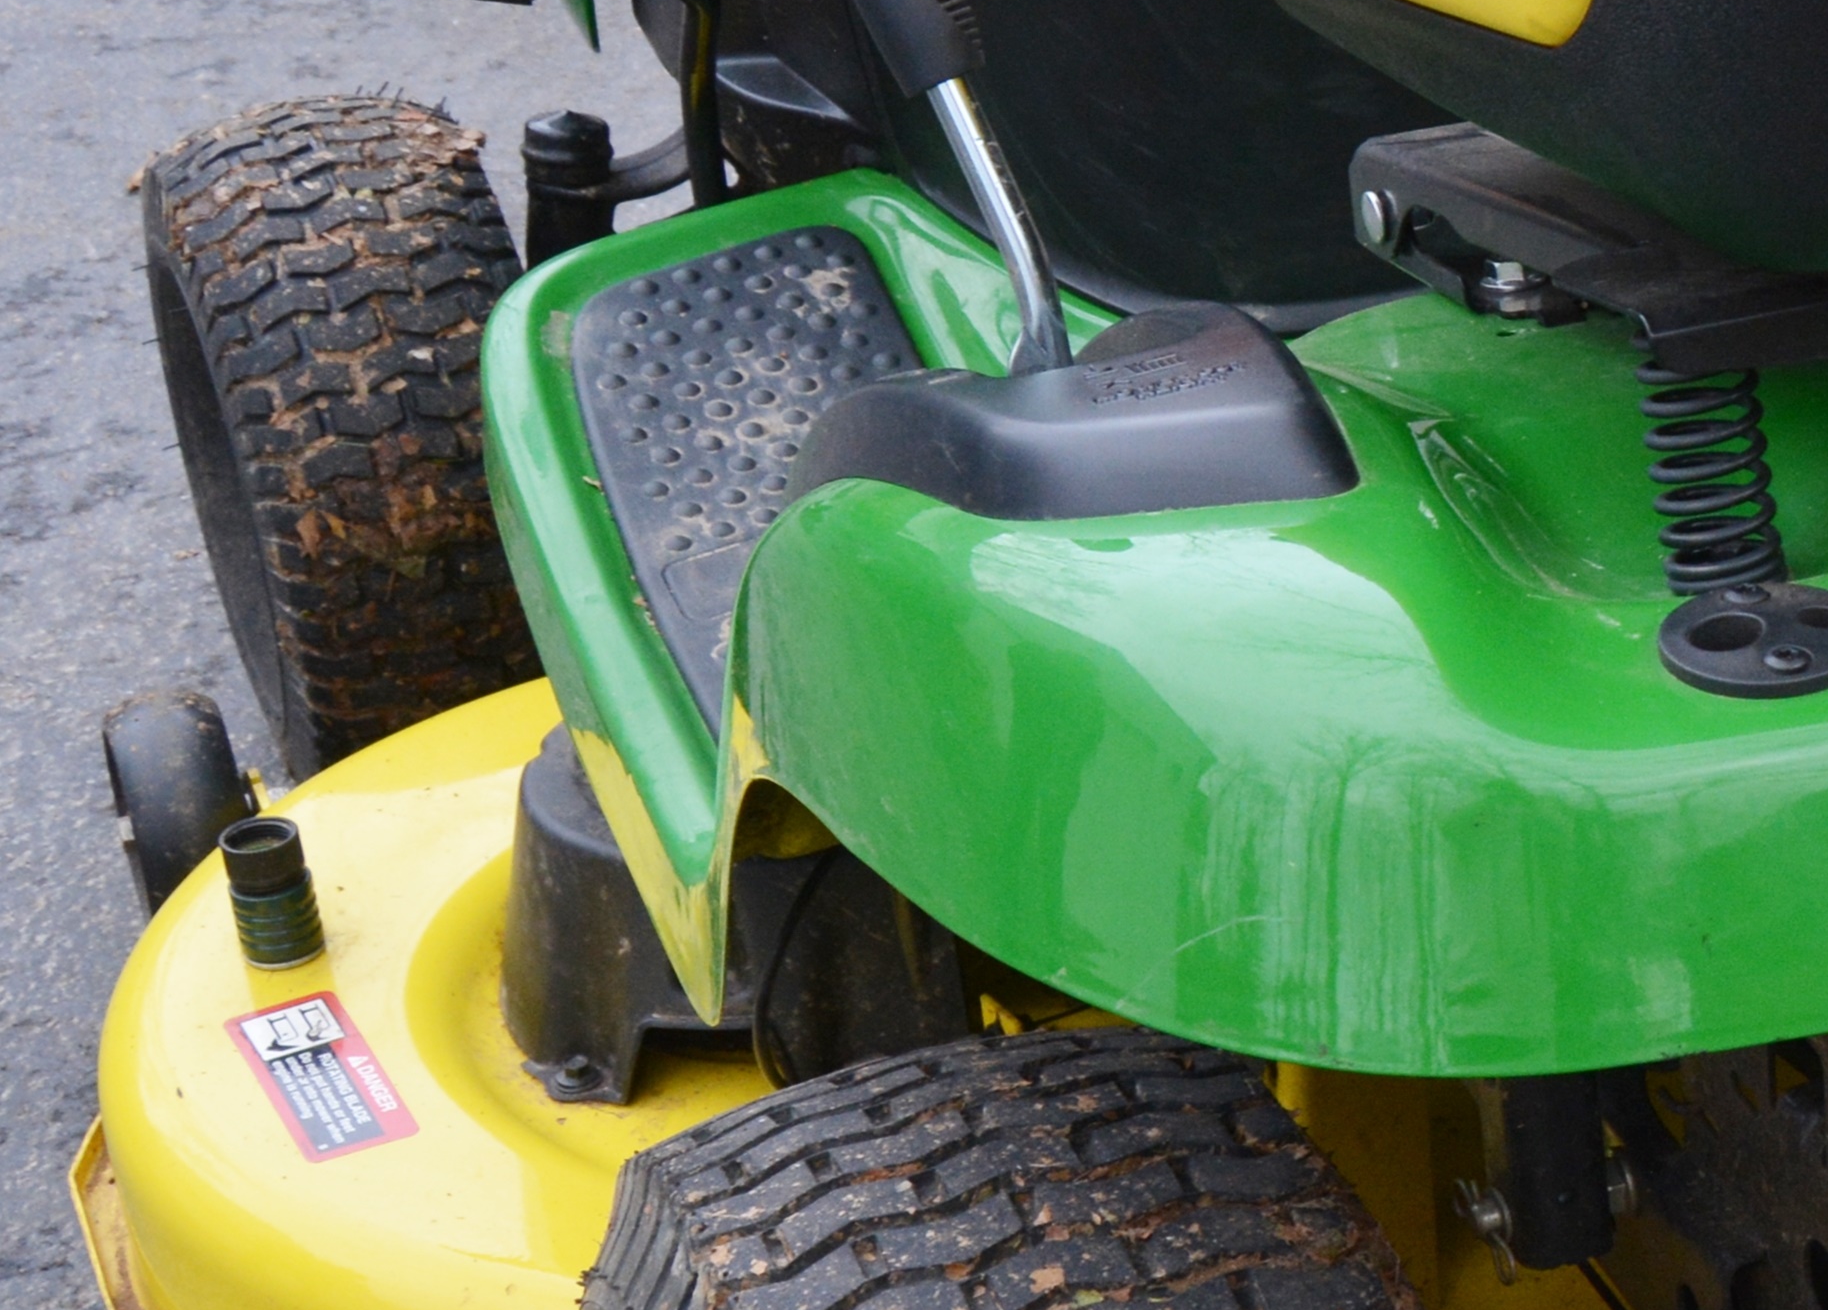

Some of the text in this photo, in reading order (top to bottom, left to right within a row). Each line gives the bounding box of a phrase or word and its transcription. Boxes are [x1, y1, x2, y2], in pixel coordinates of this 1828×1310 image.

[317, 1052, 371, 1124] ROTATING BLADE
[356, 1066, 398, 1112] DANGER
